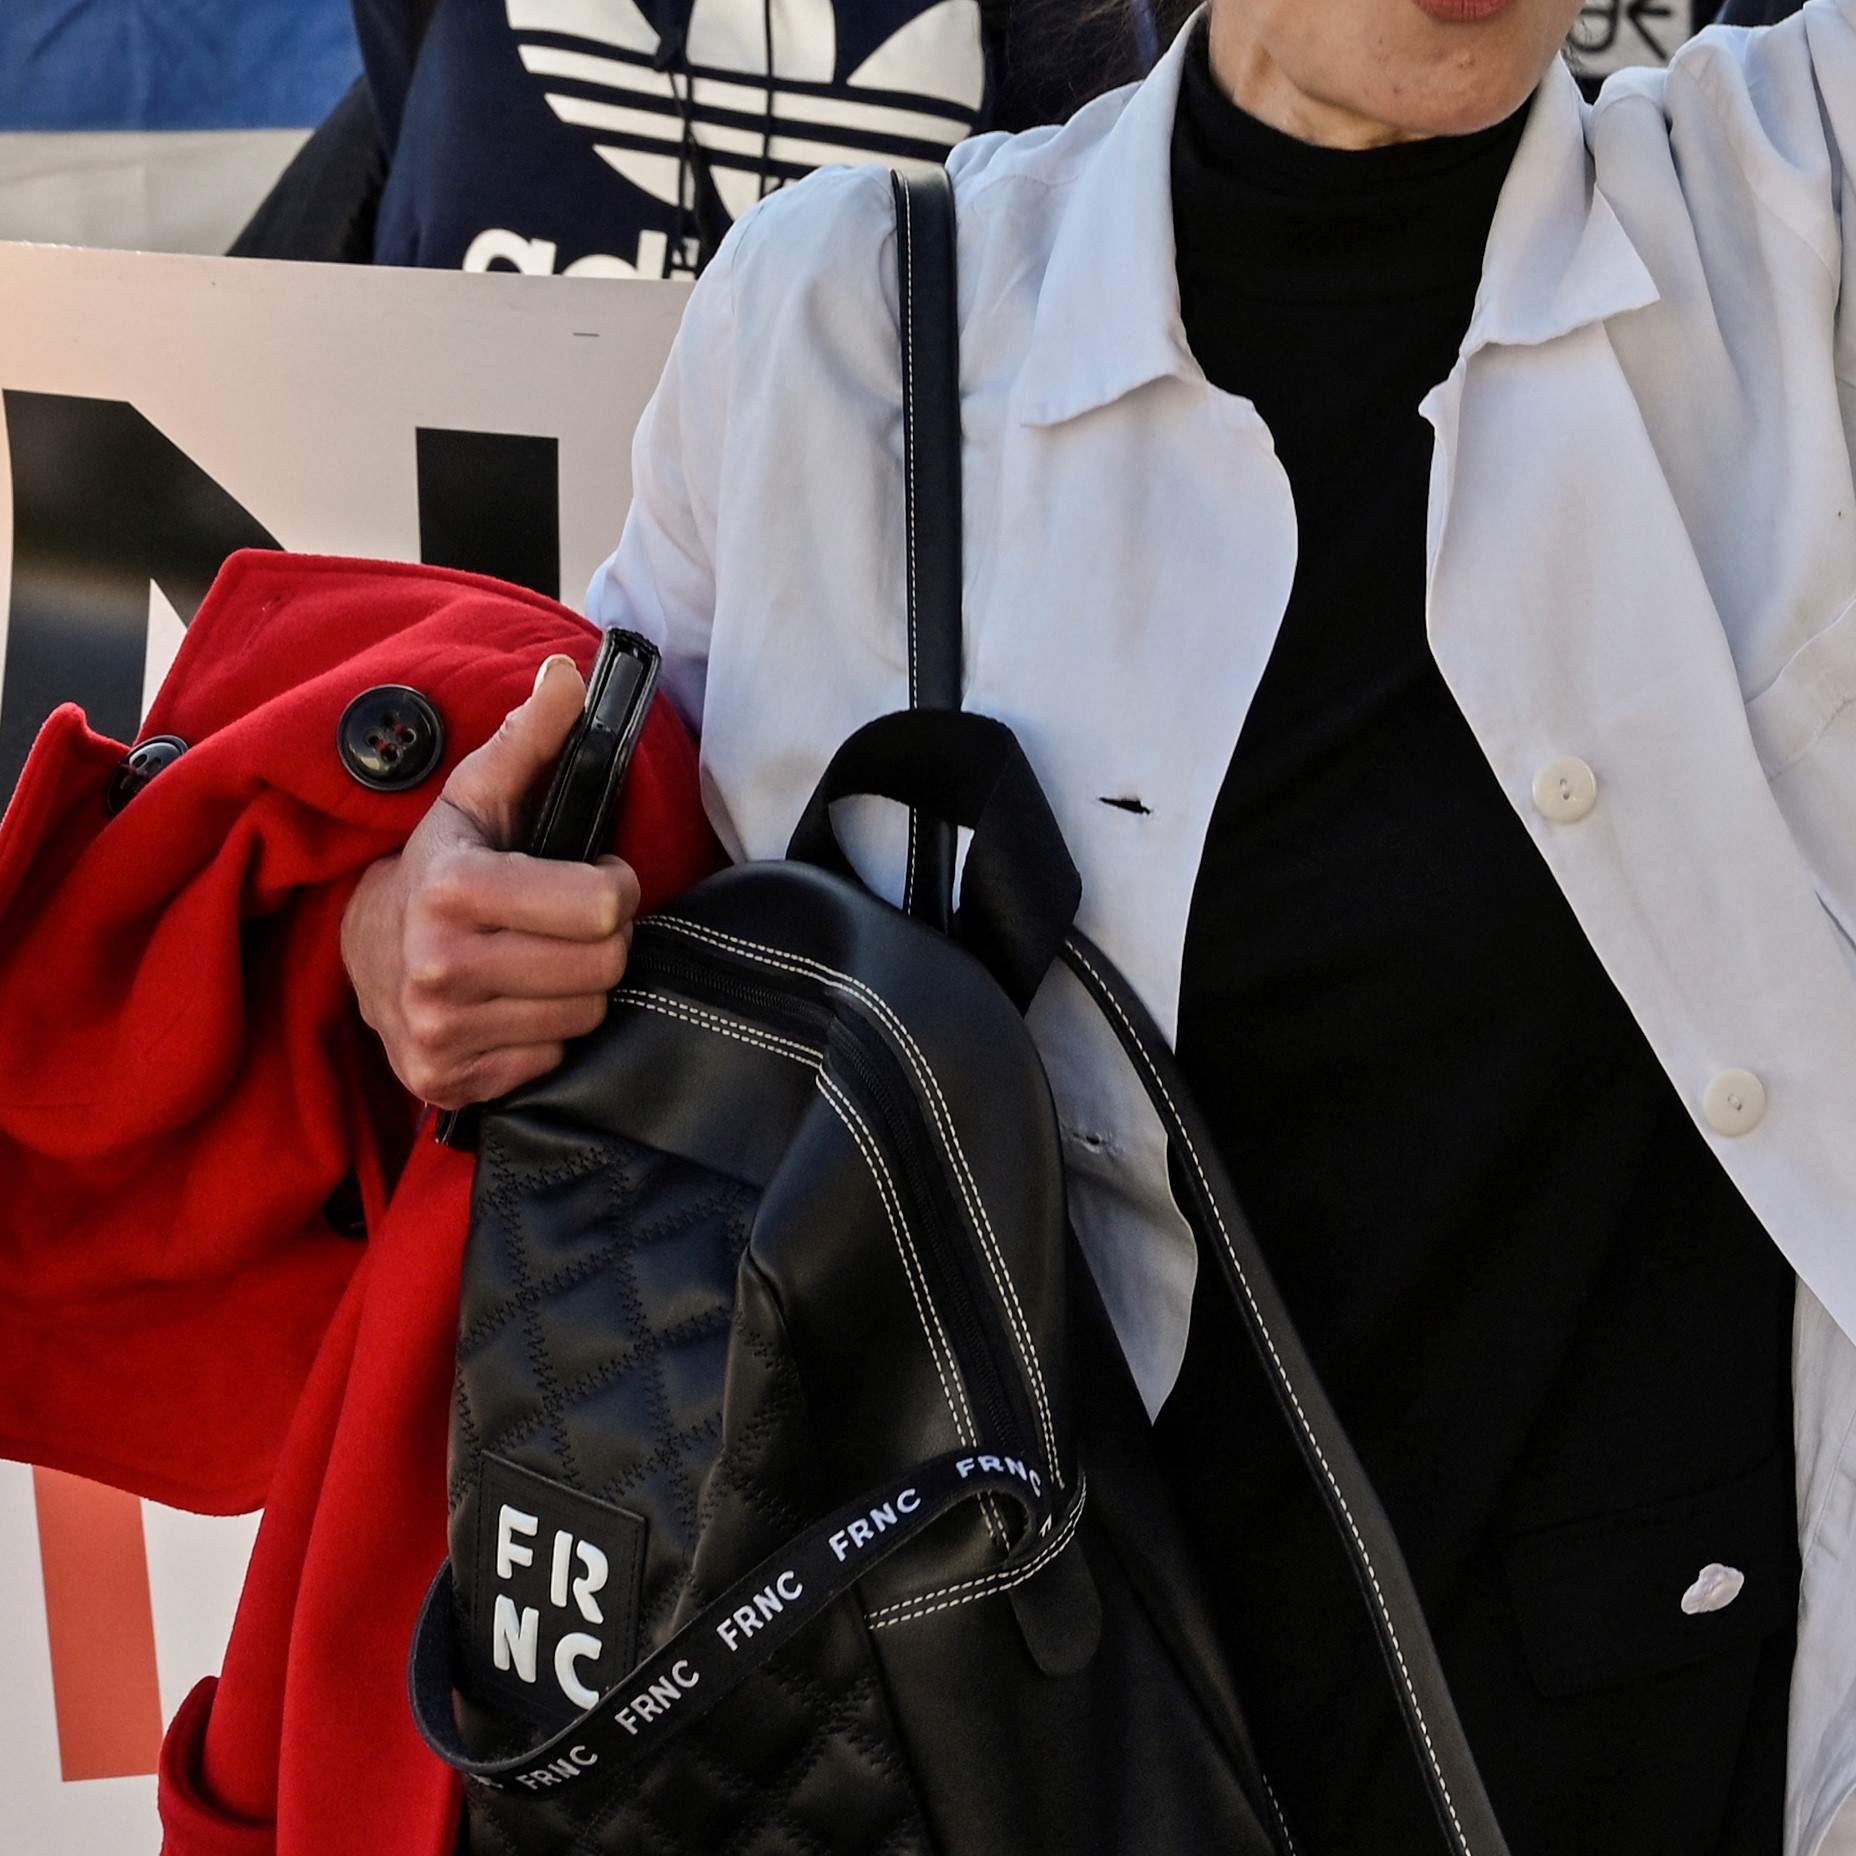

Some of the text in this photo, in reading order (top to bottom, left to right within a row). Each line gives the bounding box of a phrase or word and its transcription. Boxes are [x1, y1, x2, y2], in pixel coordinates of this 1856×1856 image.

[955, 1454, 1041, 1498] FRNC
[828, 1488, 921, 1562] FRNC
[496, 1504, 609, 1625] FR
[716, 1570, 803, 1652] FRNC
[614, 1659, 700, 1735] FRNC
[515, 1744, 599, 1791] FRNC
